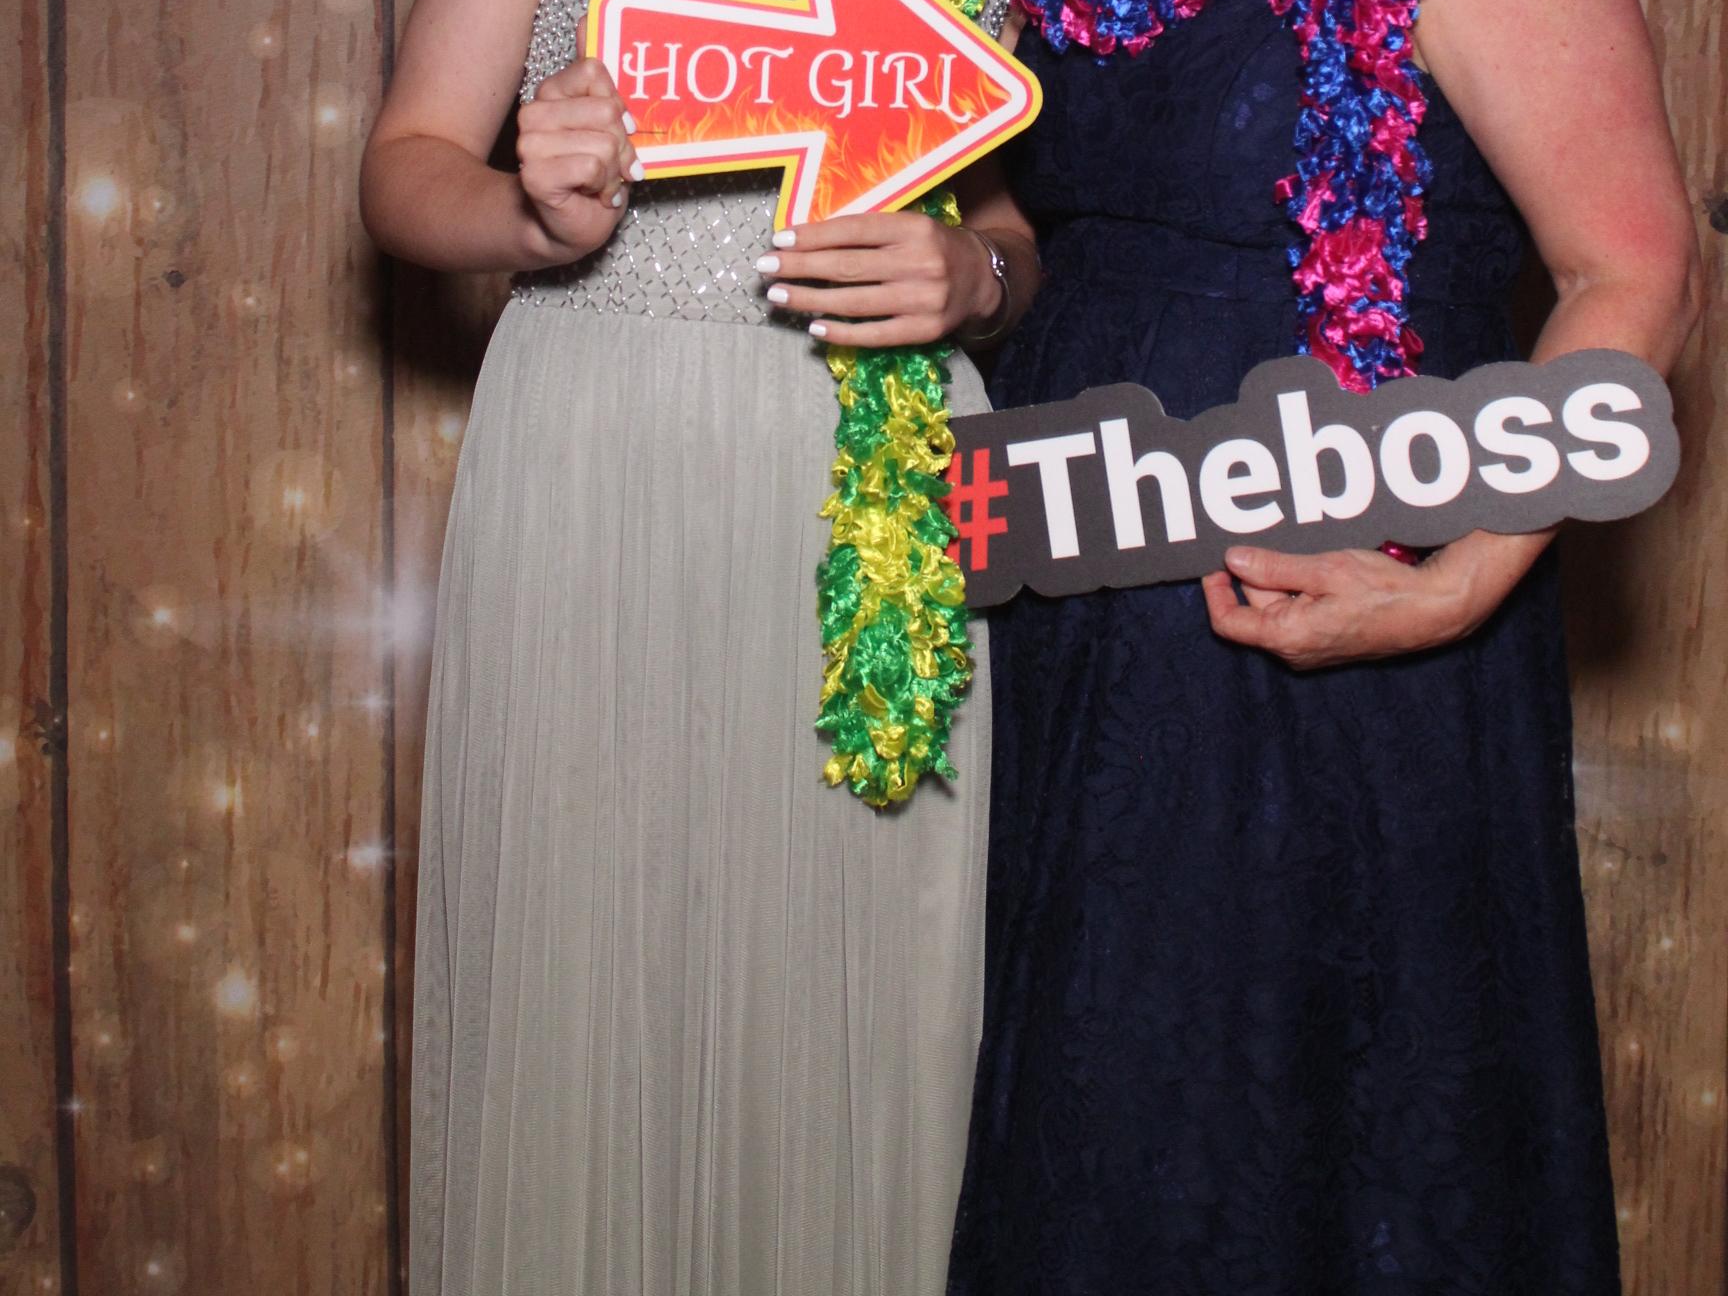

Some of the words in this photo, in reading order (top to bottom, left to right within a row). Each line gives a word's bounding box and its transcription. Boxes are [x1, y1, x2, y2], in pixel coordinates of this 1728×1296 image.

[622, 41, 794, 104] HOT
[808, 48, 974, 124] GIRL
[947, 382, 1651, 572] #Theboss
